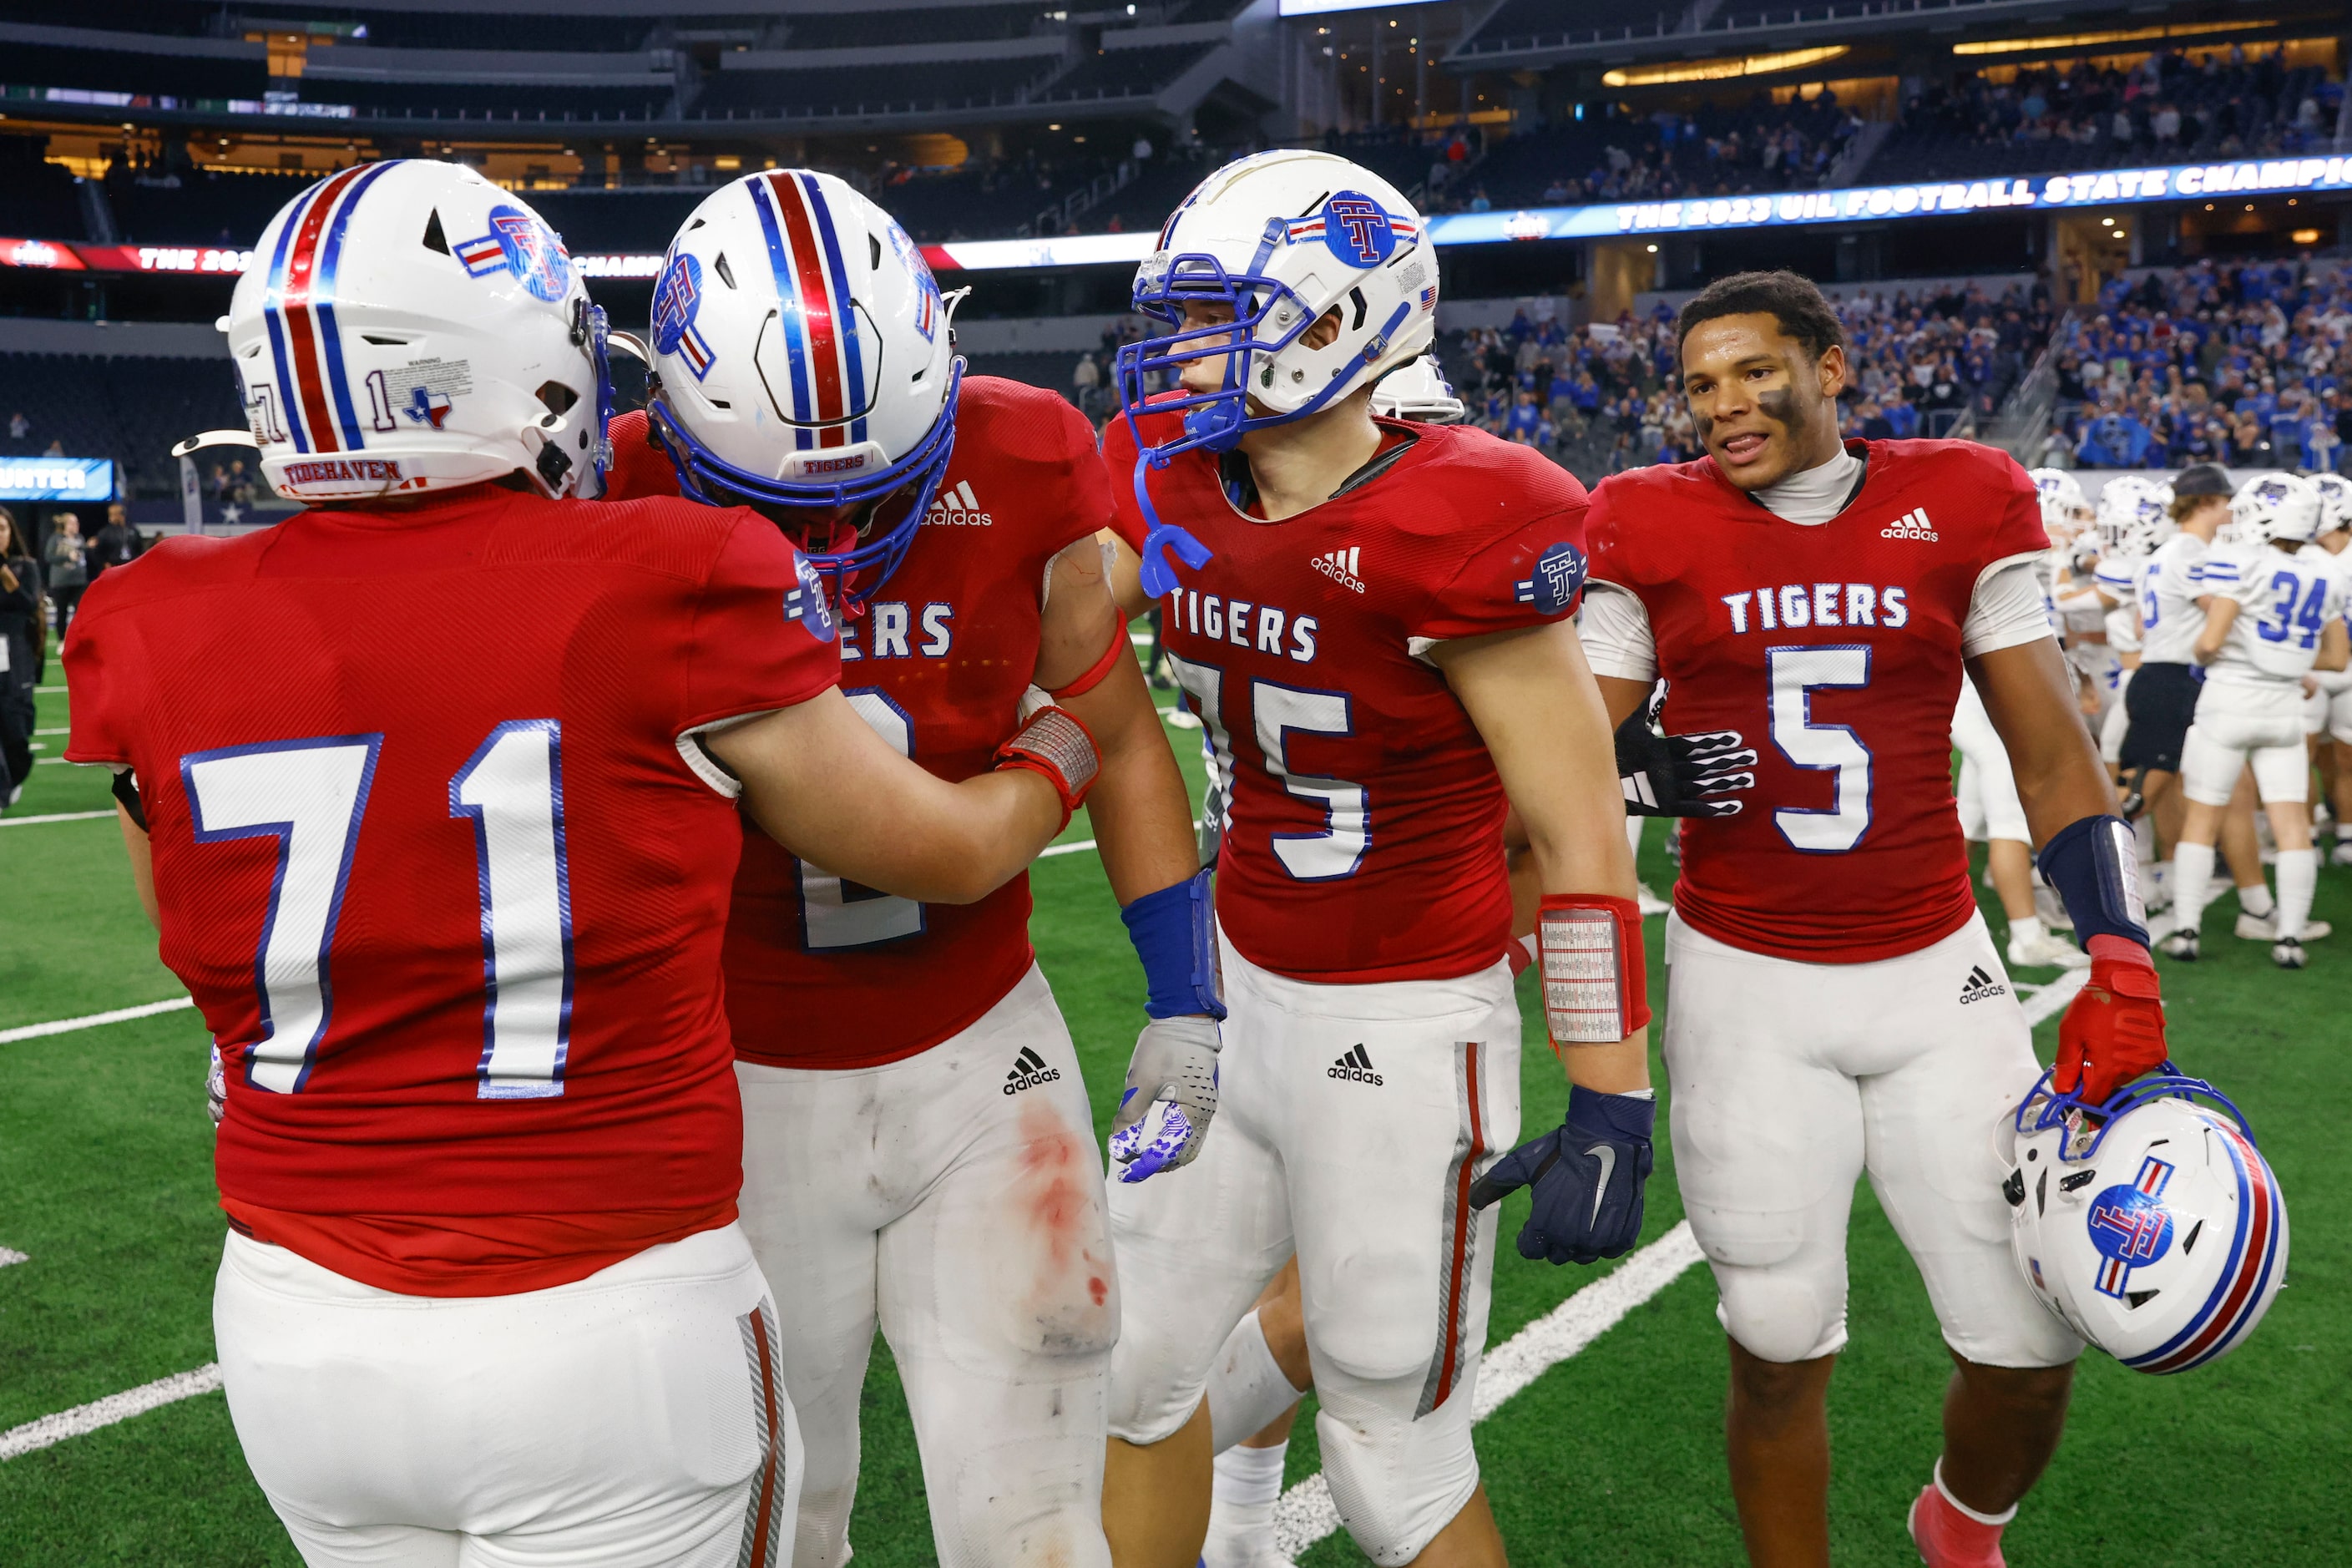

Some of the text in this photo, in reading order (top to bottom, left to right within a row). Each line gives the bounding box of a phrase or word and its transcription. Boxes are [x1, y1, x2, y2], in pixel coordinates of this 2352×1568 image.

[1616, 203, 1682, 231] THE
[1687, 197, 1772, 225] 2023
[1778, 193, 1837, 220] UIL
[1844, 179, 2036, 216] FOOTBALL
[2043, 169, 2169, 204] STATE
[139, 248, 198, 271] THE
[283, 460, 402, 486] TIDEHAVEN
[804, 453, 864, 474] TIGERS
[921, 508, 992, 526] adidas
[1880, 525, 1939, 543] adidas
[1311, 556, 1366, 594] adidas
[1721, 582, 1909, 635] TIGERS
[2258, 571, 2327, 649] 34
[1170, 586, 1319, 664] TIGERS
[1765, 645, 1874, 854] 5
[180, 718, 574, 1100] 71
[1960, 984, 2006, 1004] adidas
[1003, 1068, 1060, 1095] adidas
[1328, 1065, 1383, 1086] adidas
